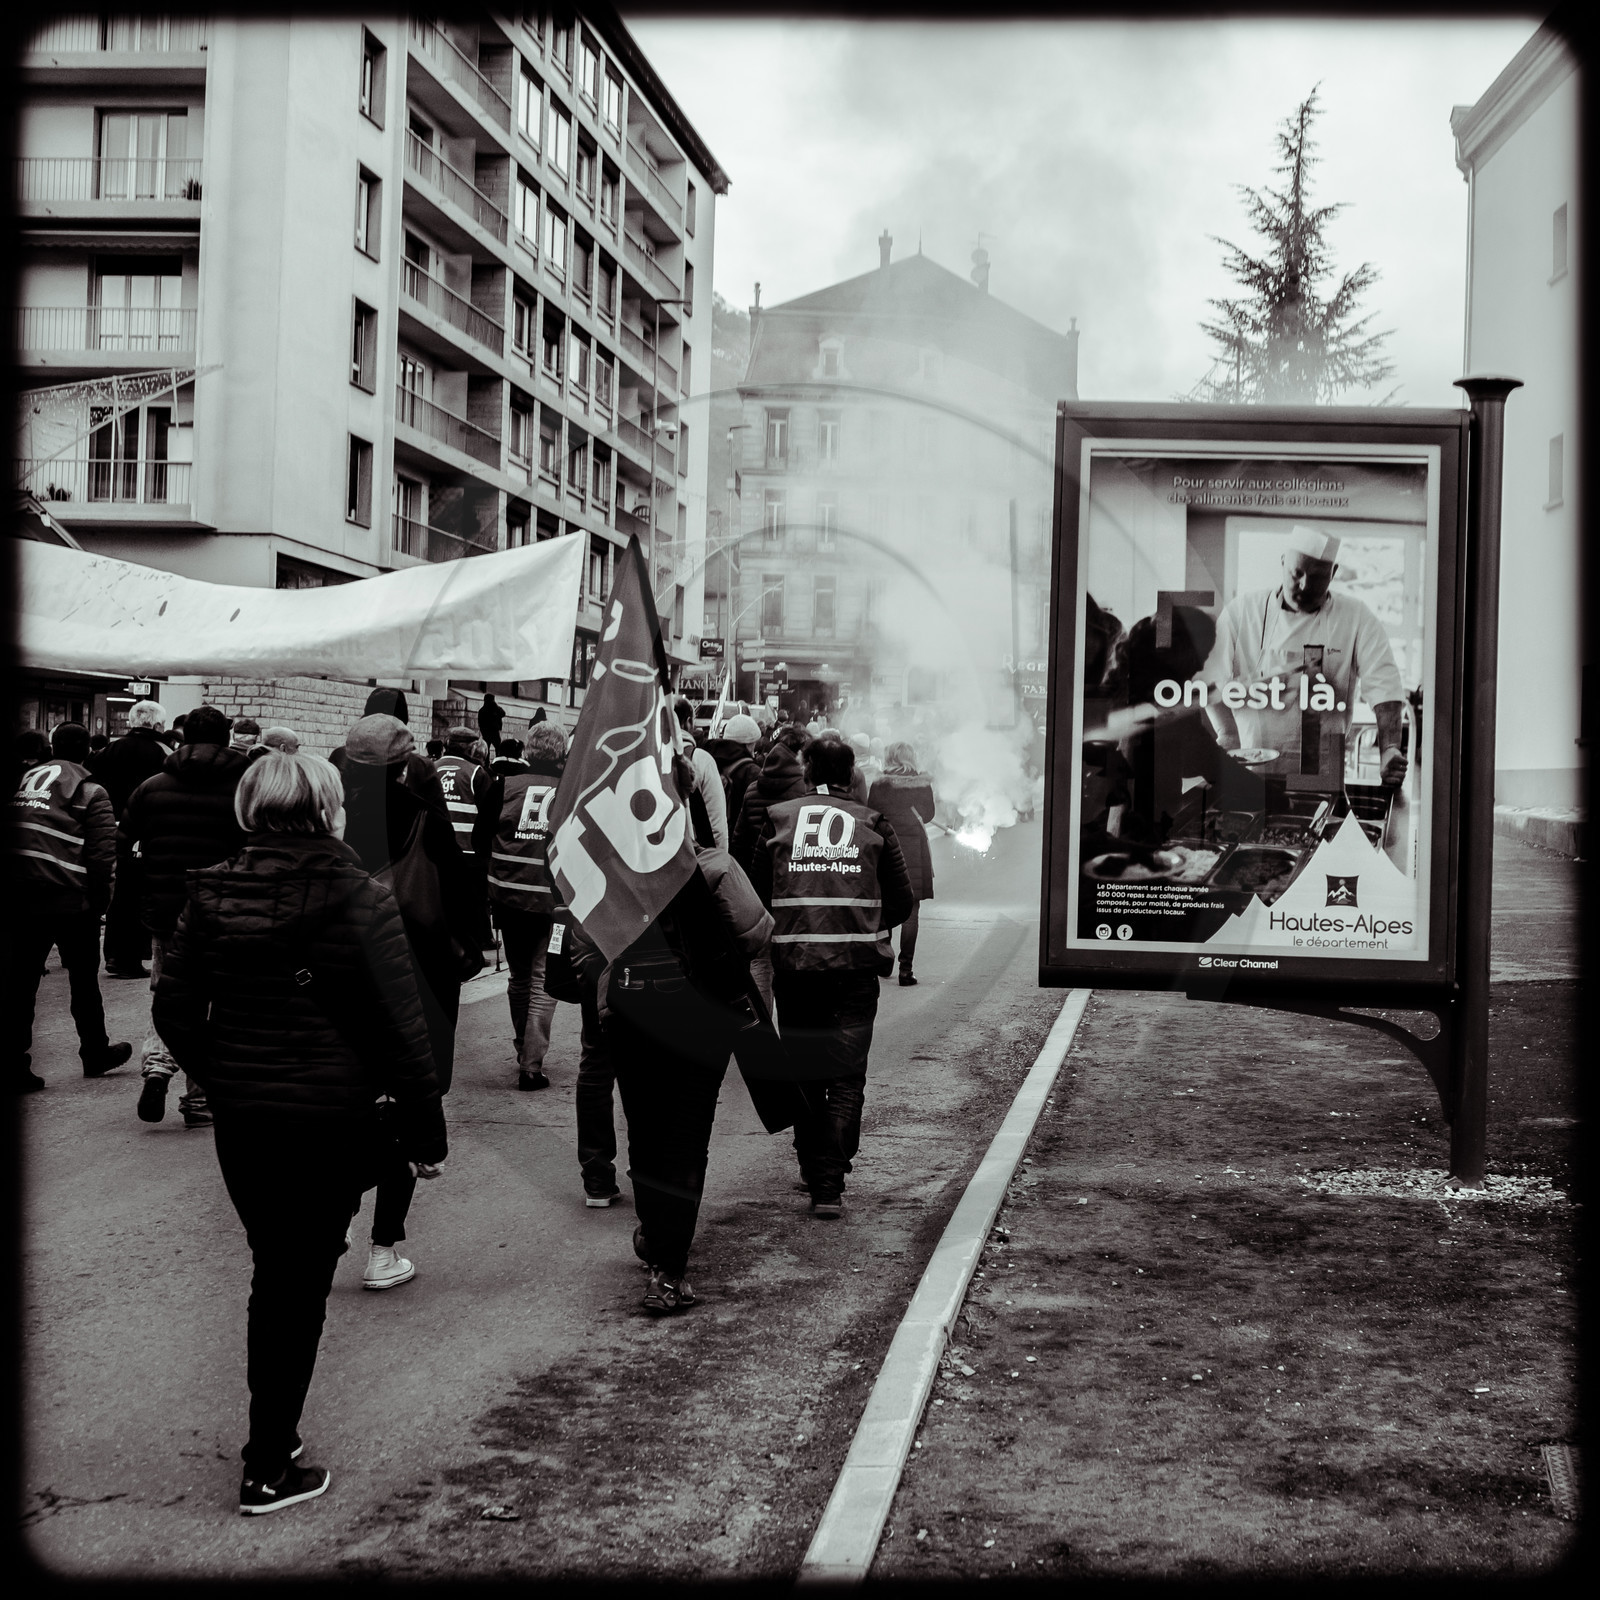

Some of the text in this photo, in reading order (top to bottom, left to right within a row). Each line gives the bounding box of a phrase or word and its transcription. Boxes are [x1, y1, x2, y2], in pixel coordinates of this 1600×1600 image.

[1173, 476, 1345, 492] Pour servir aux collégiens
[1194, 492, 1252, 505] aliments
[1154, 673, 1346, 712] on est là.
[791, 804, 856, 860] FO
[788, 861, 862, 875] Hautes-Alpes
[1106, 883, 1149, 891] Département
[1163, 885, 1188, 893] chaque
[1096, 899, 1131, 907] composés,
[1148, 900, 1171, 908] moitié,
[1159, 893, 1194, 901] collégiens,
[1123, 907, 1162, 915] producteurs
[1269, 911, 1413, 939] Hautes-Alpes
[1293, 935, 1389, 949] le département
[1213, 958, 1279, 969] Clear Channel
